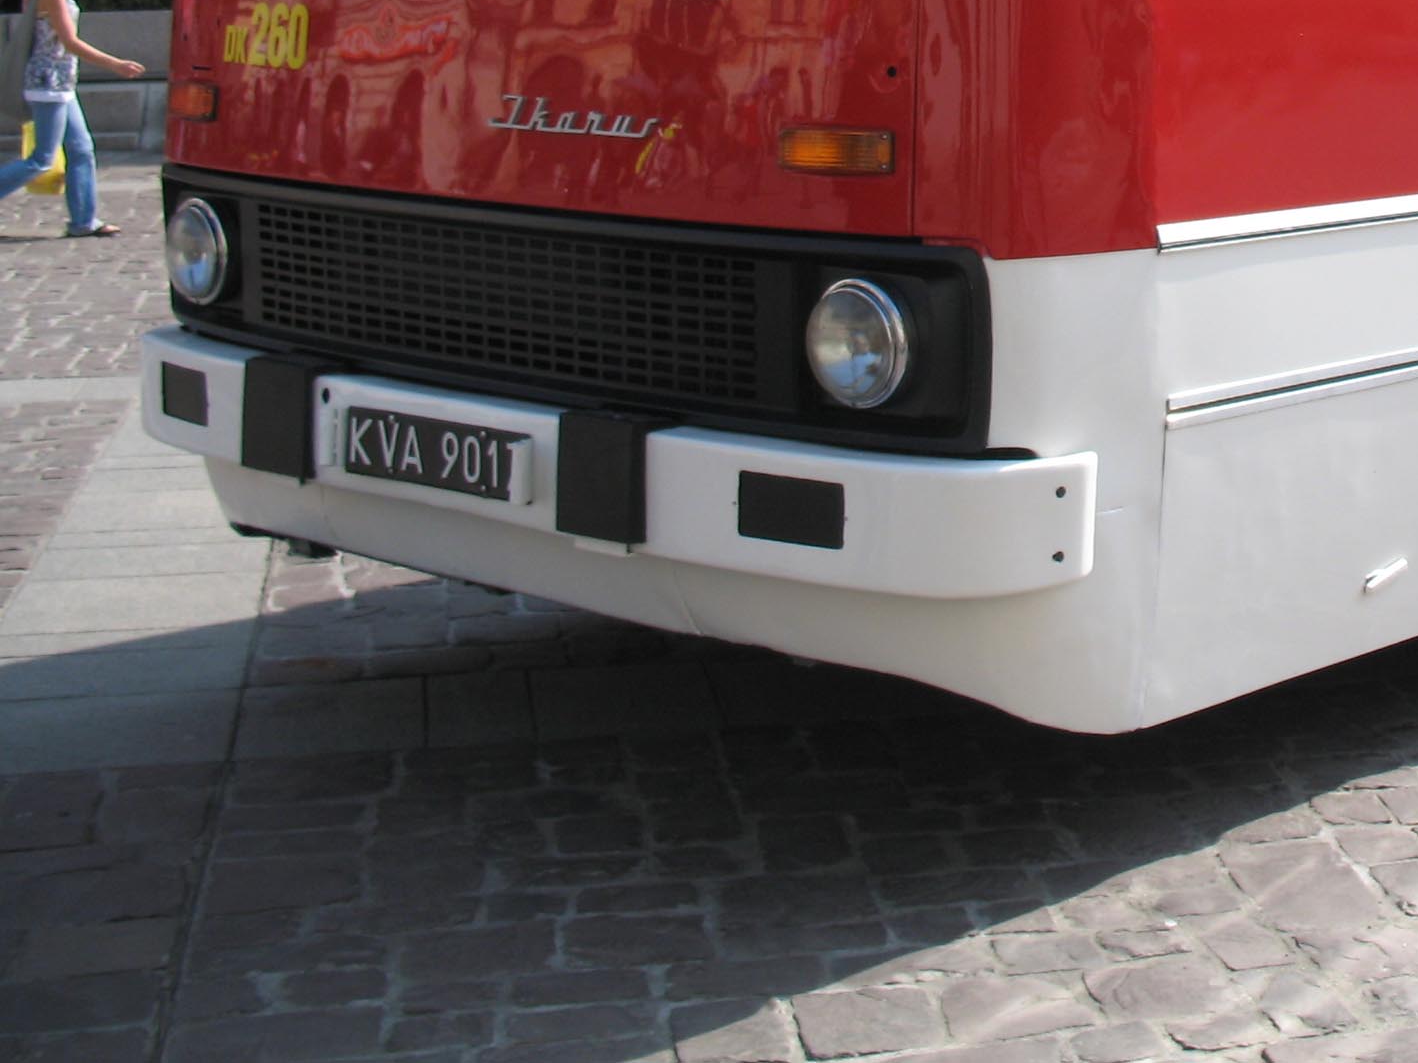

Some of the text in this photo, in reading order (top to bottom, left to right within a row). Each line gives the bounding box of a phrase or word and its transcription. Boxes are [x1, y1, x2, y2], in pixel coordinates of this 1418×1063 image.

[247, 2, 309, 69] 260
[488, 94, 659, 139] Ikarus
[350, 417, 512, 494] KVA 901
